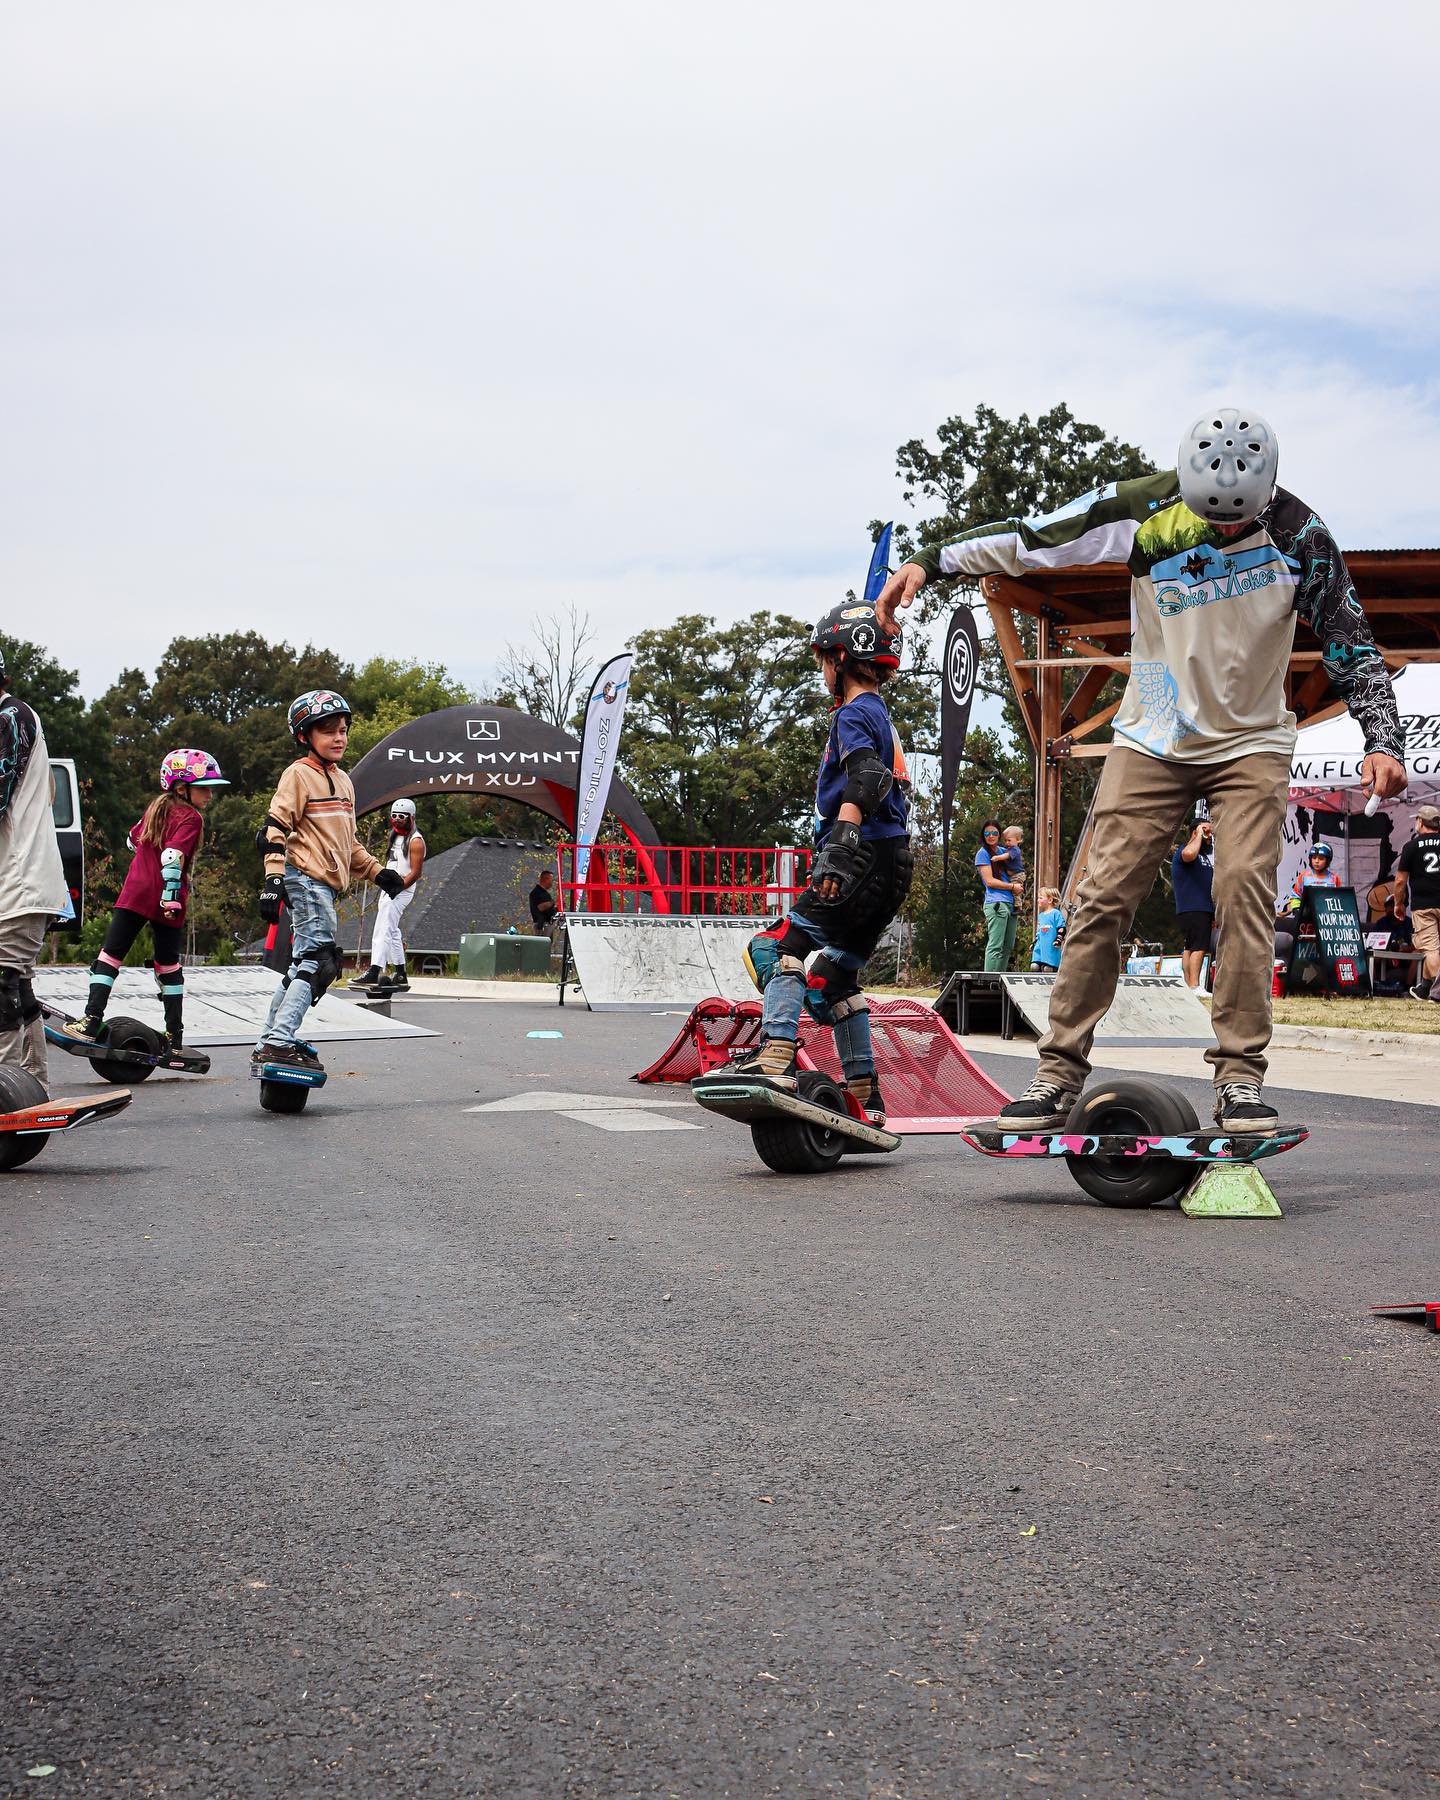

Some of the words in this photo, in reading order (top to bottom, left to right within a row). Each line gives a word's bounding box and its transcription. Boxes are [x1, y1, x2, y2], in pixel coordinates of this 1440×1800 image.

[1208, 565, 1277, 601] Mokes
[388, 748, 465, 764] FLUX
[477, 751, 580, 764] MVMNT
[1423, 852, 1440, 873] 2
[1325, 898, 1344, 911] TELL
[570, 918, 695, 928] FRESHPARK
[701, 920, 774, 928] FRESH
[1318, 914, 1338, 926] YOUR
[1338, 914, 1355, 926] MOM
[1318, 929, 1334, 941] YOU
[1335, 929, 1360, 941] JOINED
[1327, 944, 1333, 956] A
[1333, 944, 1359, 956] GANG!!
